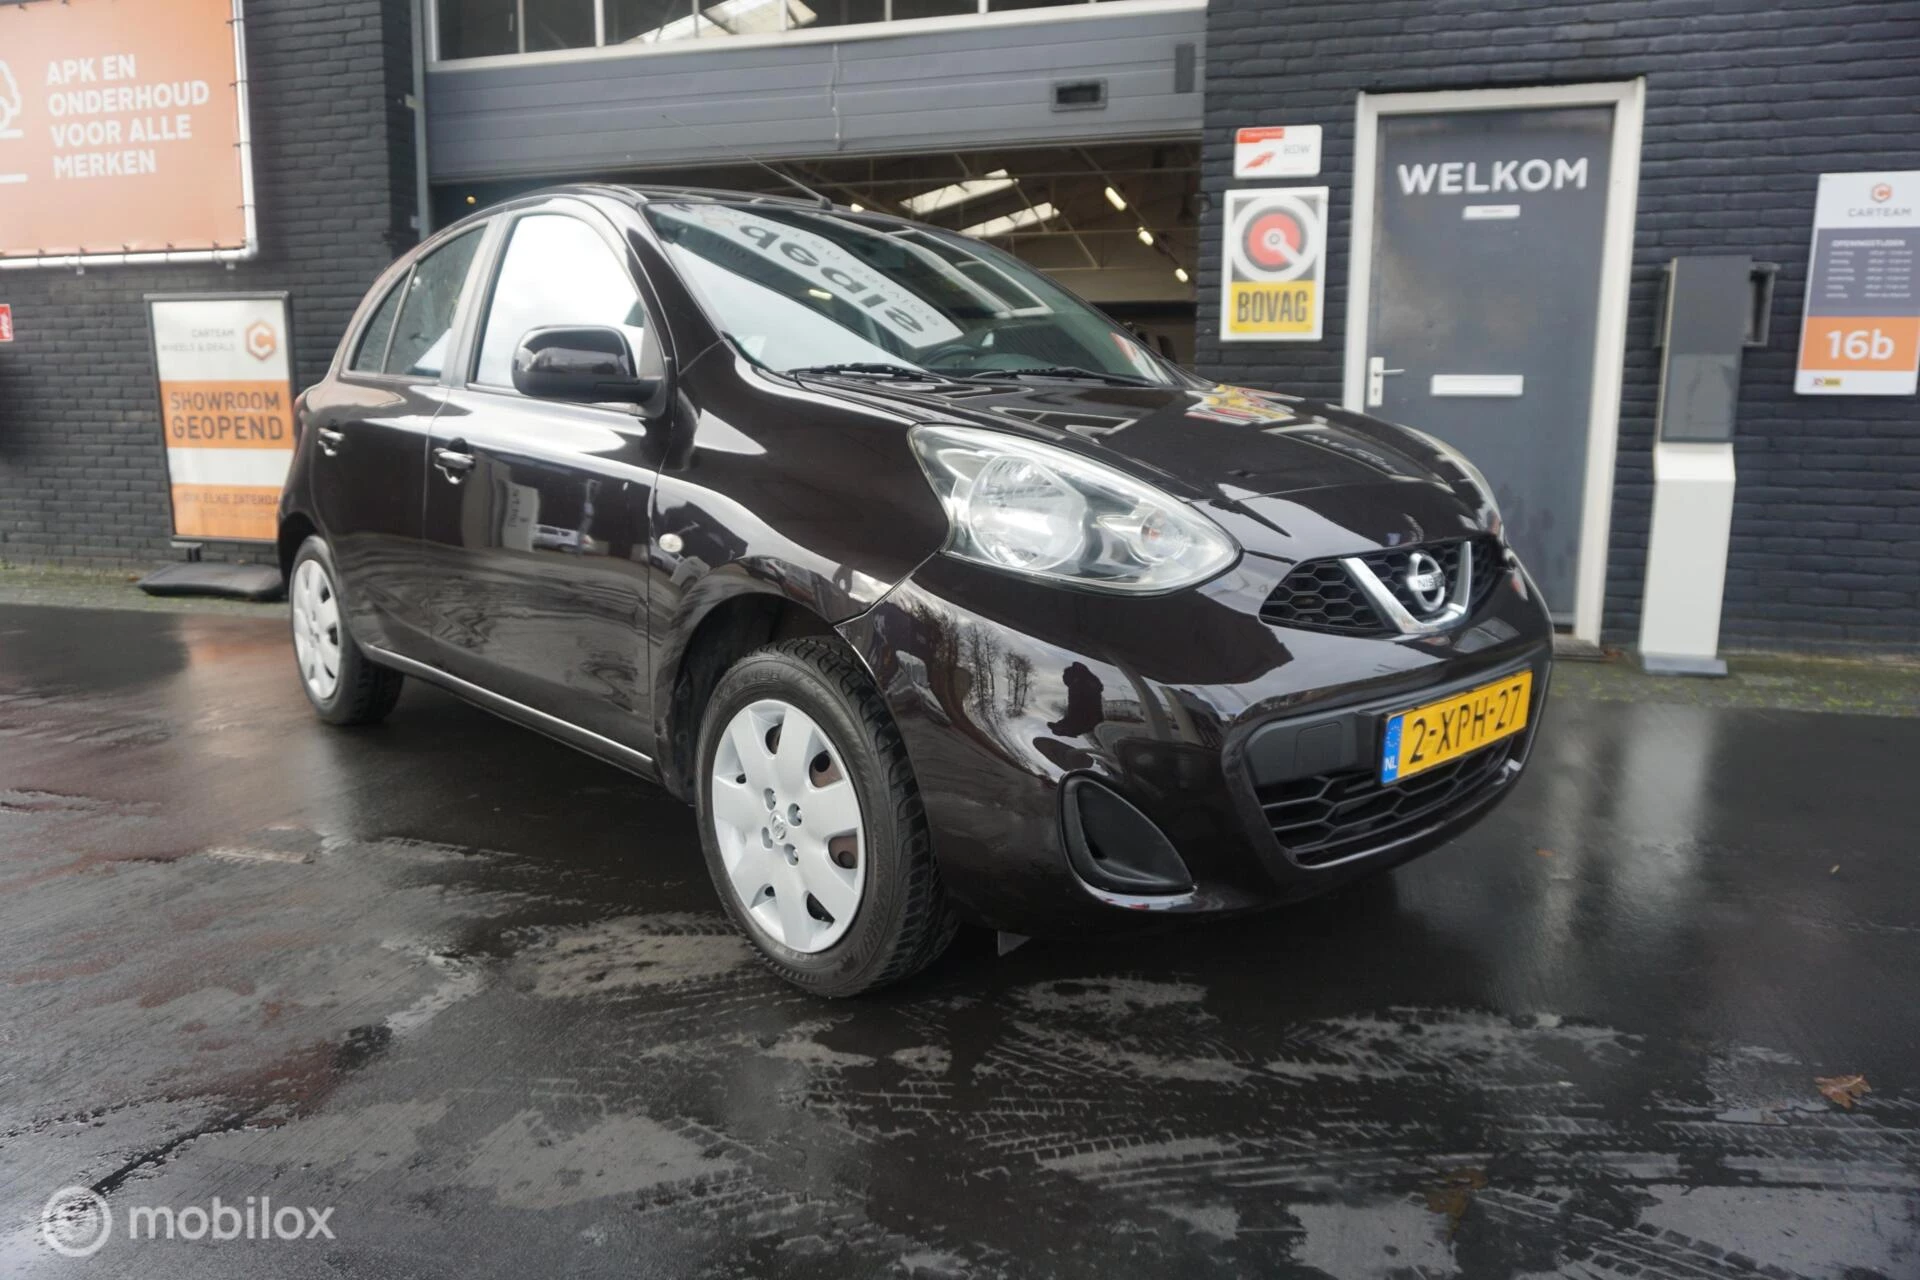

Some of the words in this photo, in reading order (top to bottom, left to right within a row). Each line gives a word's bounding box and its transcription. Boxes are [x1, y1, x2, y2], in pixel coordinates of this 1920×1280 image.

[46, 57, 96, 86] APK
[103, 54, 136, 80] EN
[48, 80, 209, 117] ONDERHOUD
[50, 120, 121, 147] VOOR
[129, 114, 192, 142] ALLE
[53, 149, 157, 179] MERKEN
[1397, 157, 1588, 195] WELKOM
[1848, 207, 1912, 218] CARTEAM
[1236, 290, 1309, 323] BOVAG
[1827, 328, 1895, 361] 16b
[170, 391, 281, 411] SHOWROOM
[172, 415, 284, 441] GEOPEND
[1409, 684, 1522, 764] 2-XPH-27
[1384, 755, 1397, 771] NL
